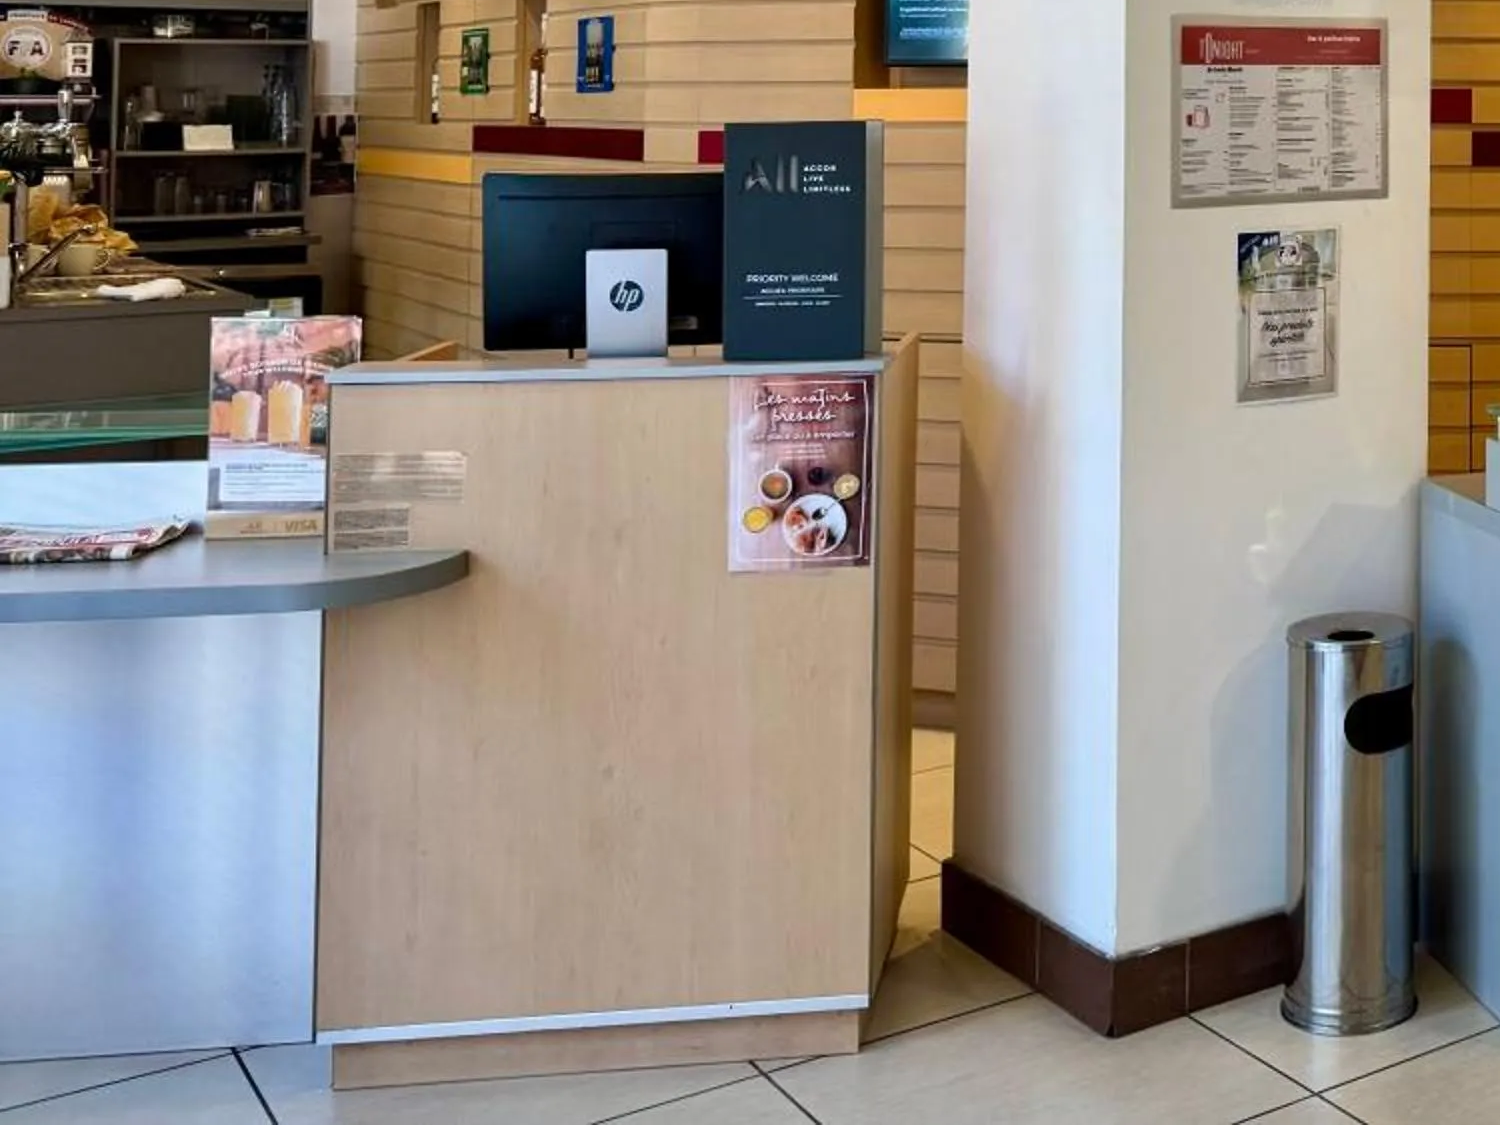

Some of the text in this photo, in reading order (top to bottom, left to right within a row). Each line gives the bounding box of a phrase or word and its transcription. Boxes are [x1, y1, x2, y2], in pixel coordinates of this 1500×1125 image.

[803, 164, 838, 172] ACCOR
[803, 185, 852, 193] LIMITLESS
[746, 273, 839, 283] PRIORITY WELCOME
[615, 280, 641, 311] hp
[285, 519, 318, 532] VISA
